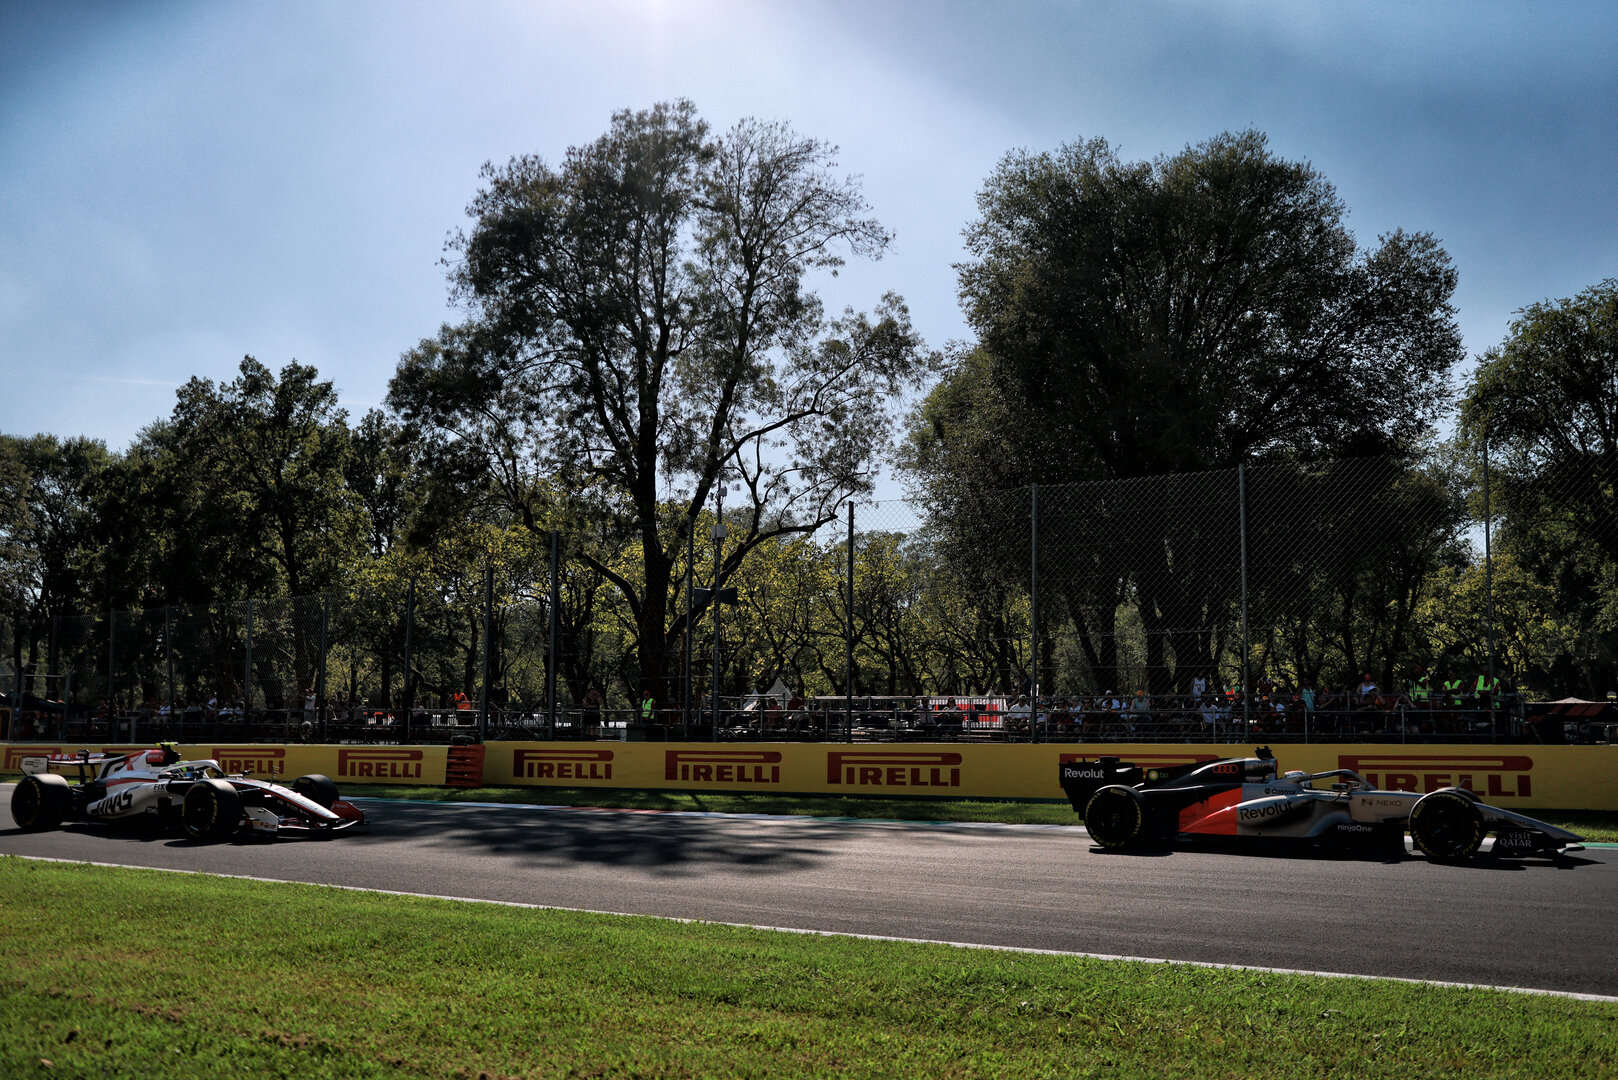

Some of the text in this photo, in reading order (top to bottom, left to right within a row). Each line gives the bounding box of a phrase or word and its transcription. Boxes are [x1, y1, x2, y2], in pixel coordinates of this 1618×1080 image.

[211, 748, 286, 774] PIRELLI
[338, 750, 423, 778] PIRELLI
[513, 749, 614, 780] PIRELLI
[665, 750, 782, 783] PIRELLI
[827, 752, 962, 787] PIRELLI
[1064, 767, 1105, 779] Revolut
[1239, 800, 1293, 821] Revolut
[1376, 799, 1402, 807] NEXO
[1337, 824, 1373, 832] ninjaOne
[1508, 831, 1532, 840] visit
[1499, 838, 1532, 848] QATAR
